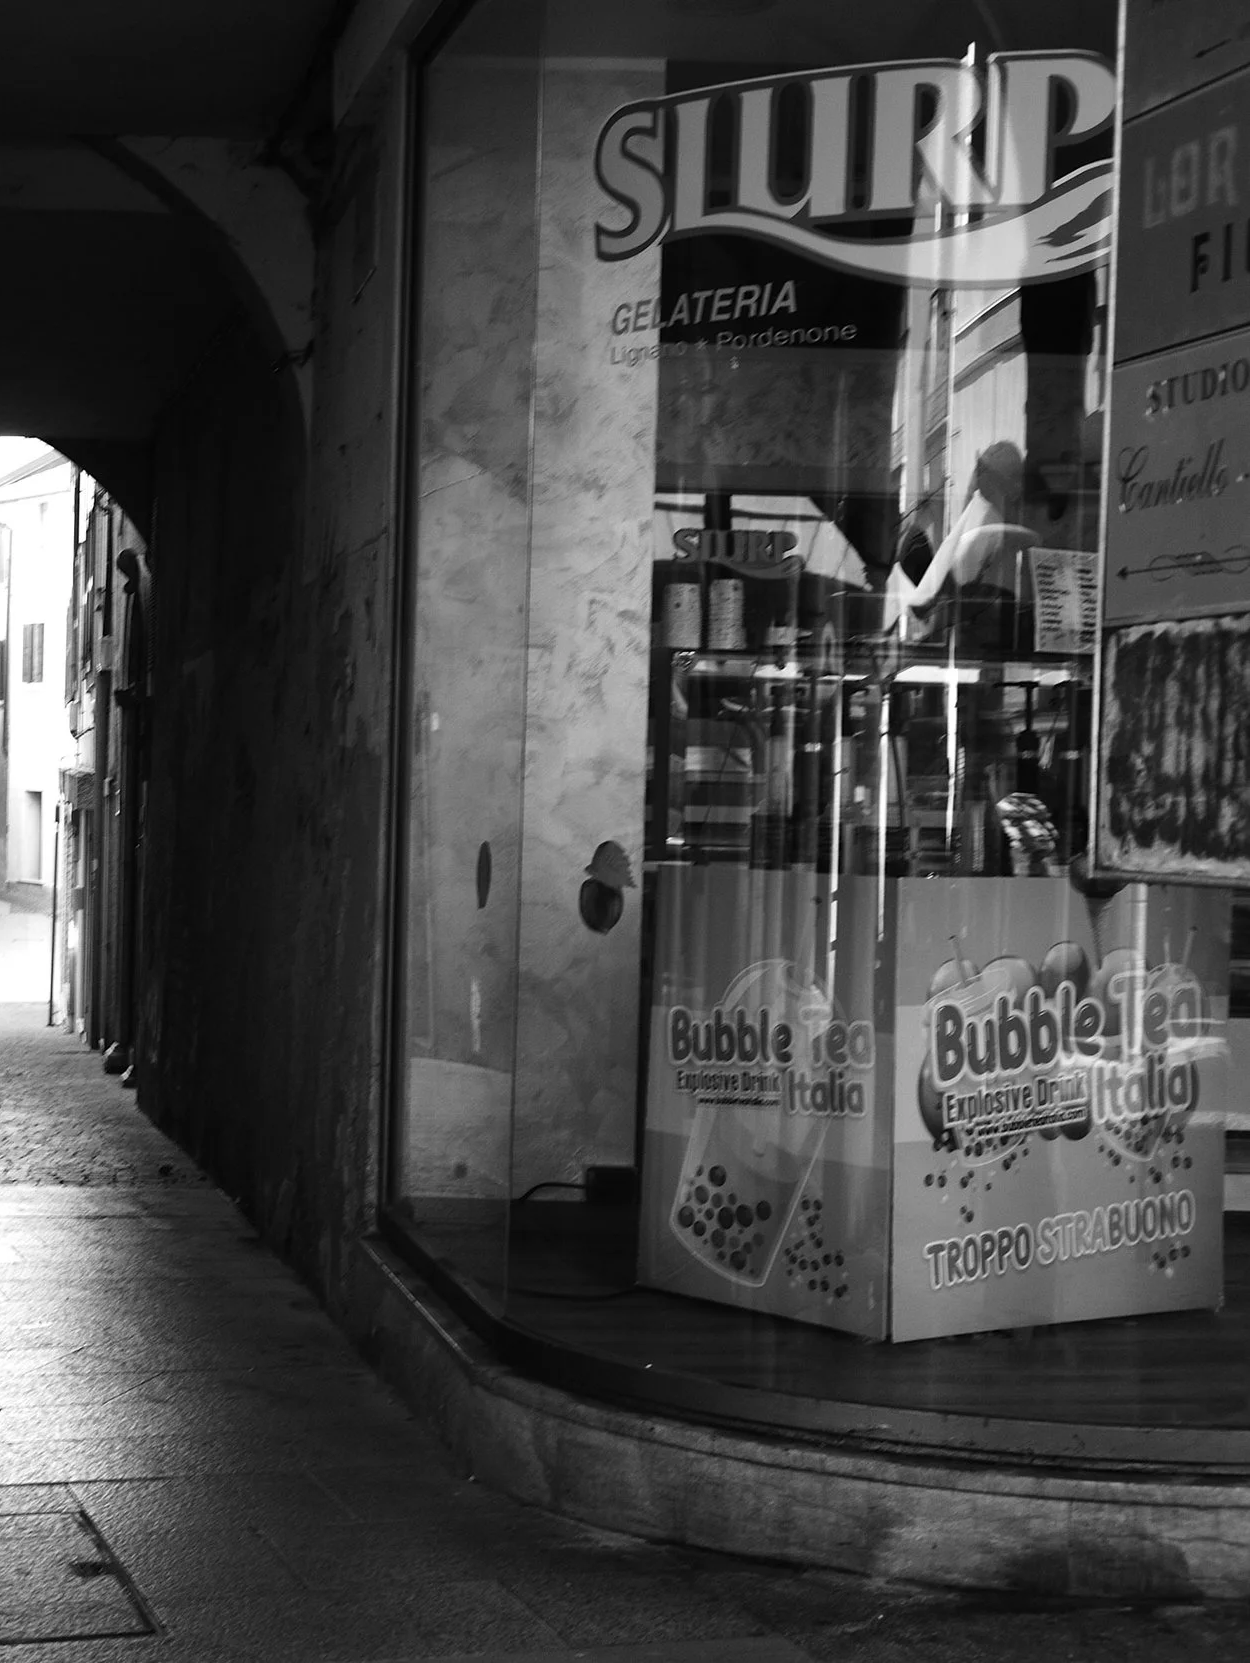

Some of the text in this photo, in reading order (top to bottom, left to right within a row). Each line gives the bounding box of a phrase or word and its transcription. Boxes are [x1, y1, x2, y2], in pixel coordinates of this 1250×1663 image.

[595, 48, 1117, 262] SLURP
[1190, 216, 1250, 293] FI
[611, 279, 799, 337] GELATERIA
[716, 322, 859, 351] Pordenone
[1146, 356, 1250, 415] STUDIO
[673, 528, 797, 563] SLURP
[669, 1005, 876, 1068] Bubble Tea
[933, 968, 1203, 1091] Bubble Tea
[676, 1069, 782, 1096] Explosive Drink
[786, 1066, 867, 1118] Italia
[944, 1082, 1033, 1127] Explosive
[1035, 1074, 1086, 1107] Drink
[1092, 1052, 1196, 1124] Italia
[924, 1189, 1196, 1290] TROPPO STRABUONO
